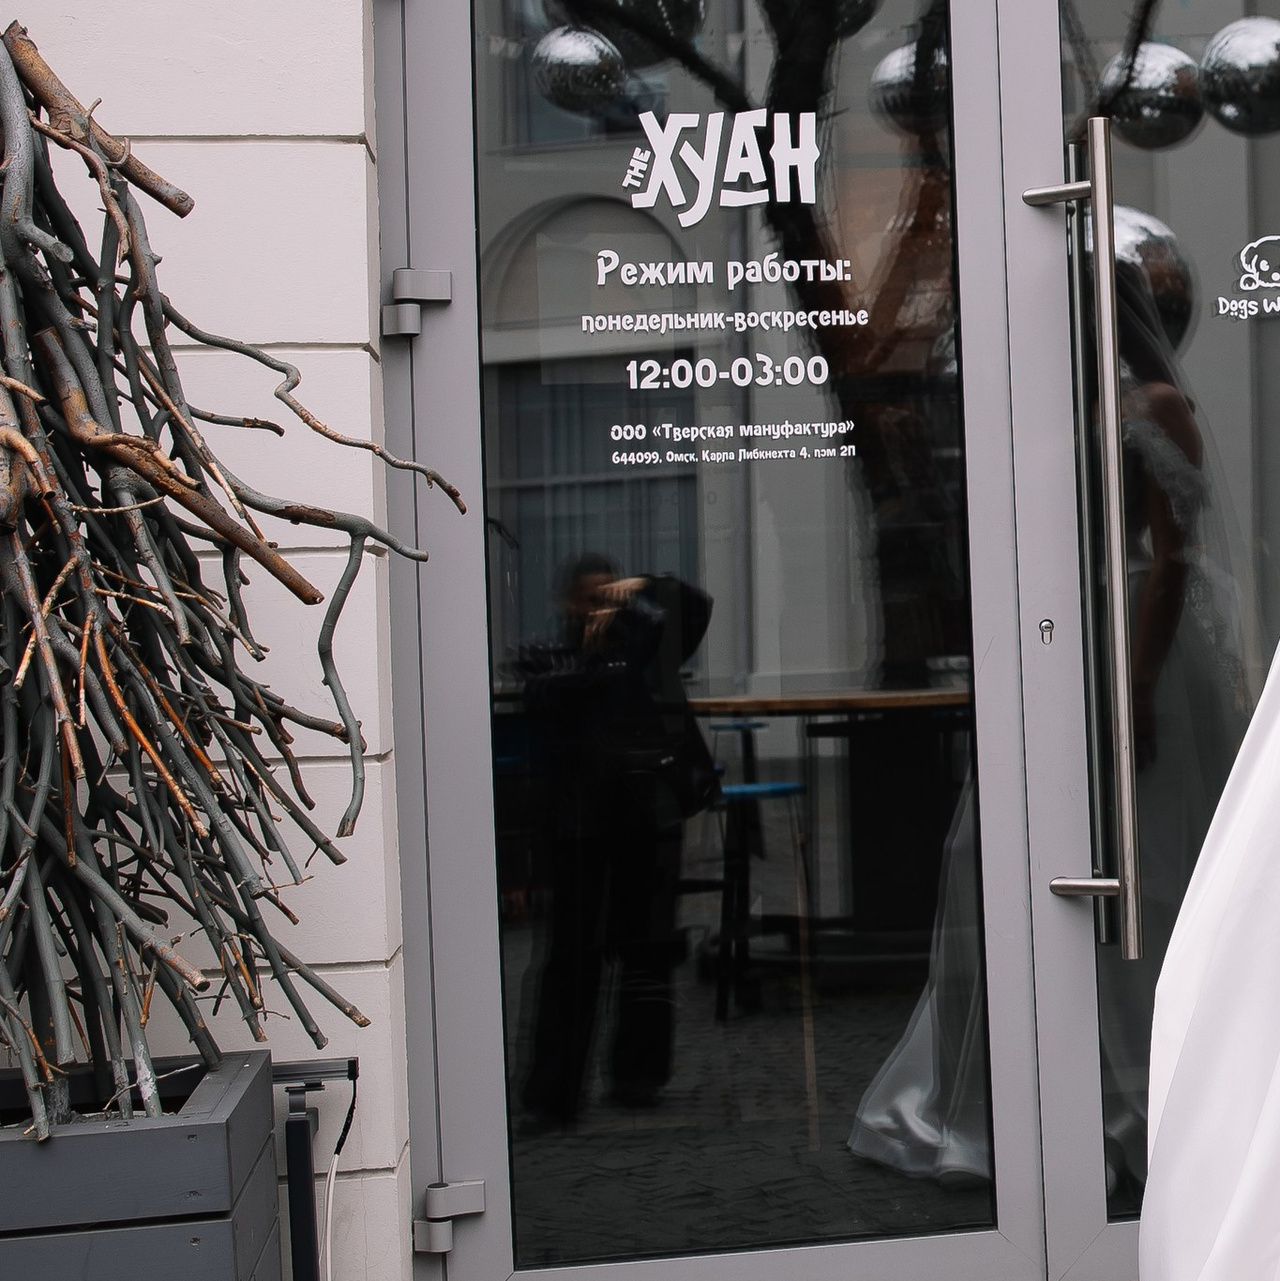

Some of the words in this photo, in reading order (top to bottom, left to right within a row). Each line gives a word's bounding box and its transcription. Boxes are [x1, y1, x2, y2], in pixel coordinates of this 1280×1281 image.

[621, 146, 652, 189] THE
[596, 249, 714, 287] Режим
[726, 252, 852, 291] работы:
[1217, 296, 1259, 320] Dogs
[581, 309, 869, 334] понедельник-воскресенье
[626, 352, 829, 389] 12:00-03:00
[610, 424, 647, 441] ООО
[652, 424, 734, 442] «Тверская
[739, 420, 855, 440] мануфактура»
[701, 449, 735, 464] Карла
[738, 447, 796, 463] Либкнехта
[839, 445, 856, 457] 2П
